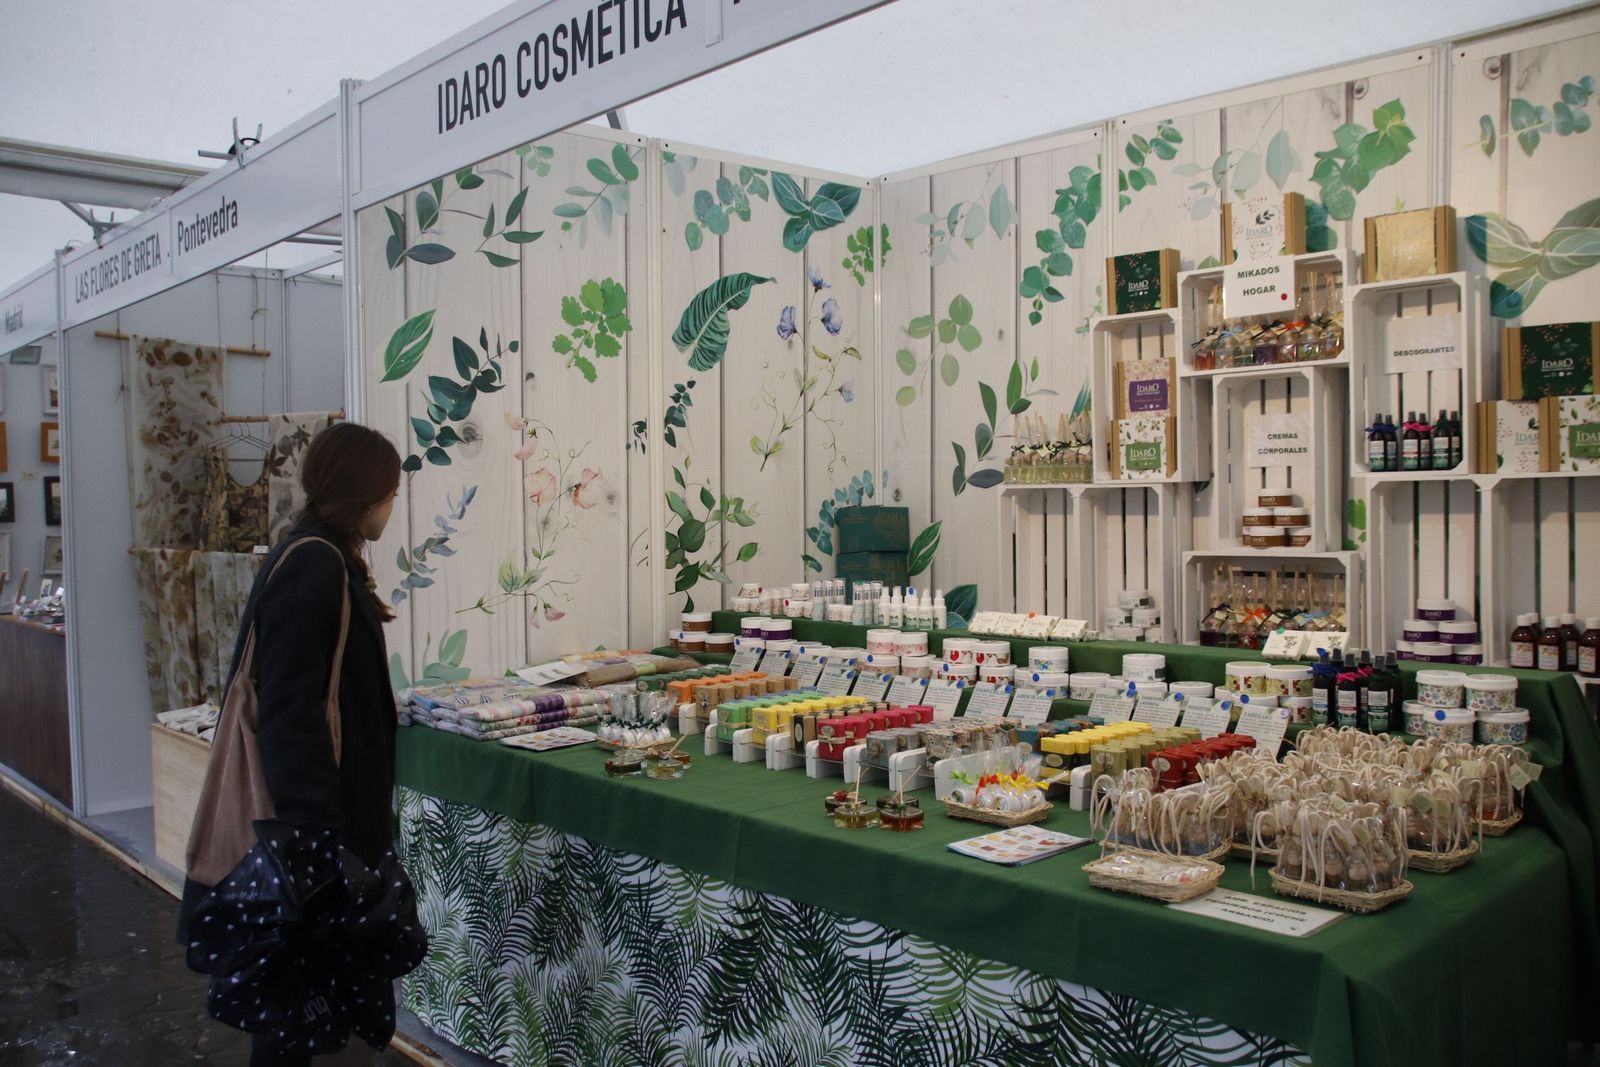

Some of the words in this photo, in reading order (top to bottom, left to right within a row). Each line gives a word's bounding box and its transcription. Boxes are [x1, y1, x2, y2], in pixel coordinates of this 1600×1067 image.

[438, 53, 507, 134] IDARO
[177, 195, 238, 256] Pontevedra
[75, 270, 89, 303] LAS
[90, 254, 120, 297] FLORES
[121, 248, 132, 283] DE
[133, 232, 162, 276] GRETA
[1237, 265, 1280, 279] MIKADOS
[1242, 284, 1276, 297] HOGAR
[1541, 358, 1574, 369] IDARO
[1136, 383, 1160, 394] IDARO
[1130, 447, 1157, 458] IDARO
[1258, 447, 1308, 455] CORPORALES
